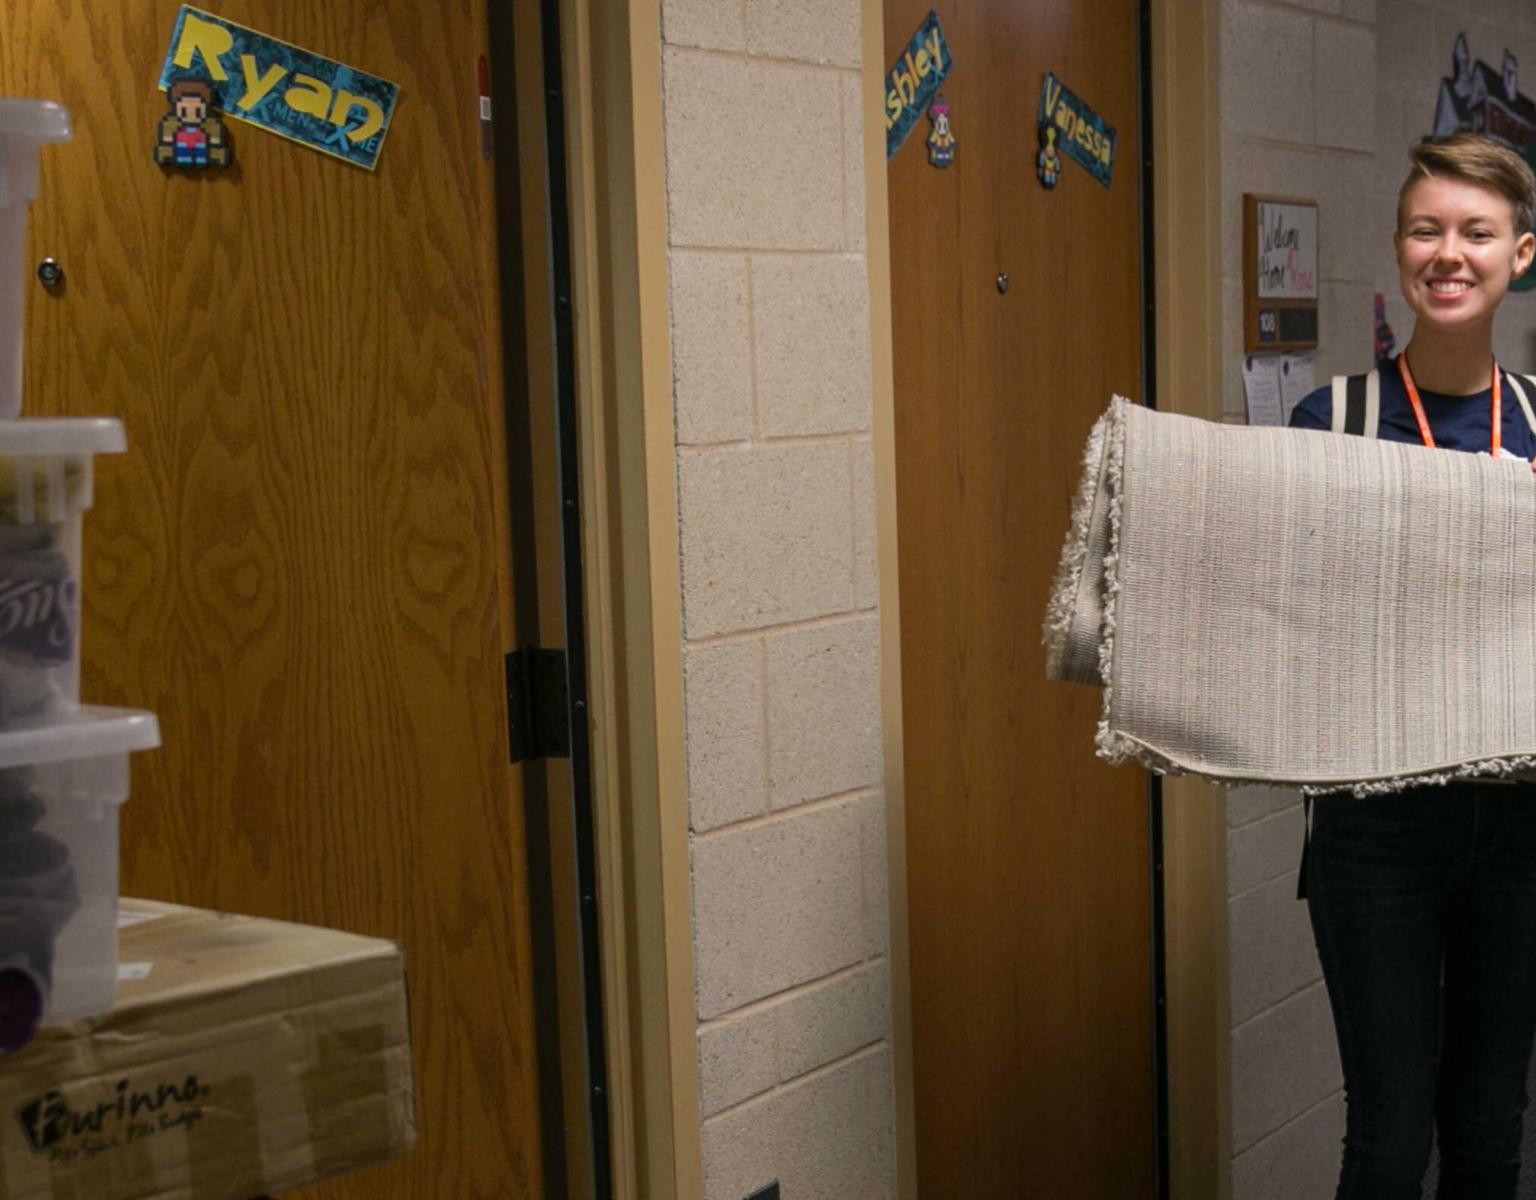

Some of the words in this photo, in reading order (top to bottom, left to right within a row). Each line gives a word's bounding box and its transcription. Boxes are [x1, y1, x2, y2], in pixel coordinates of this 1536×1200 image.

[173, 13, 384, 143] Ryan
[1044, 74, 1111, 166] Vanessa
[1260, 203, 1300, 253] Welcome
[1259, 255, 1286, 291] Home
